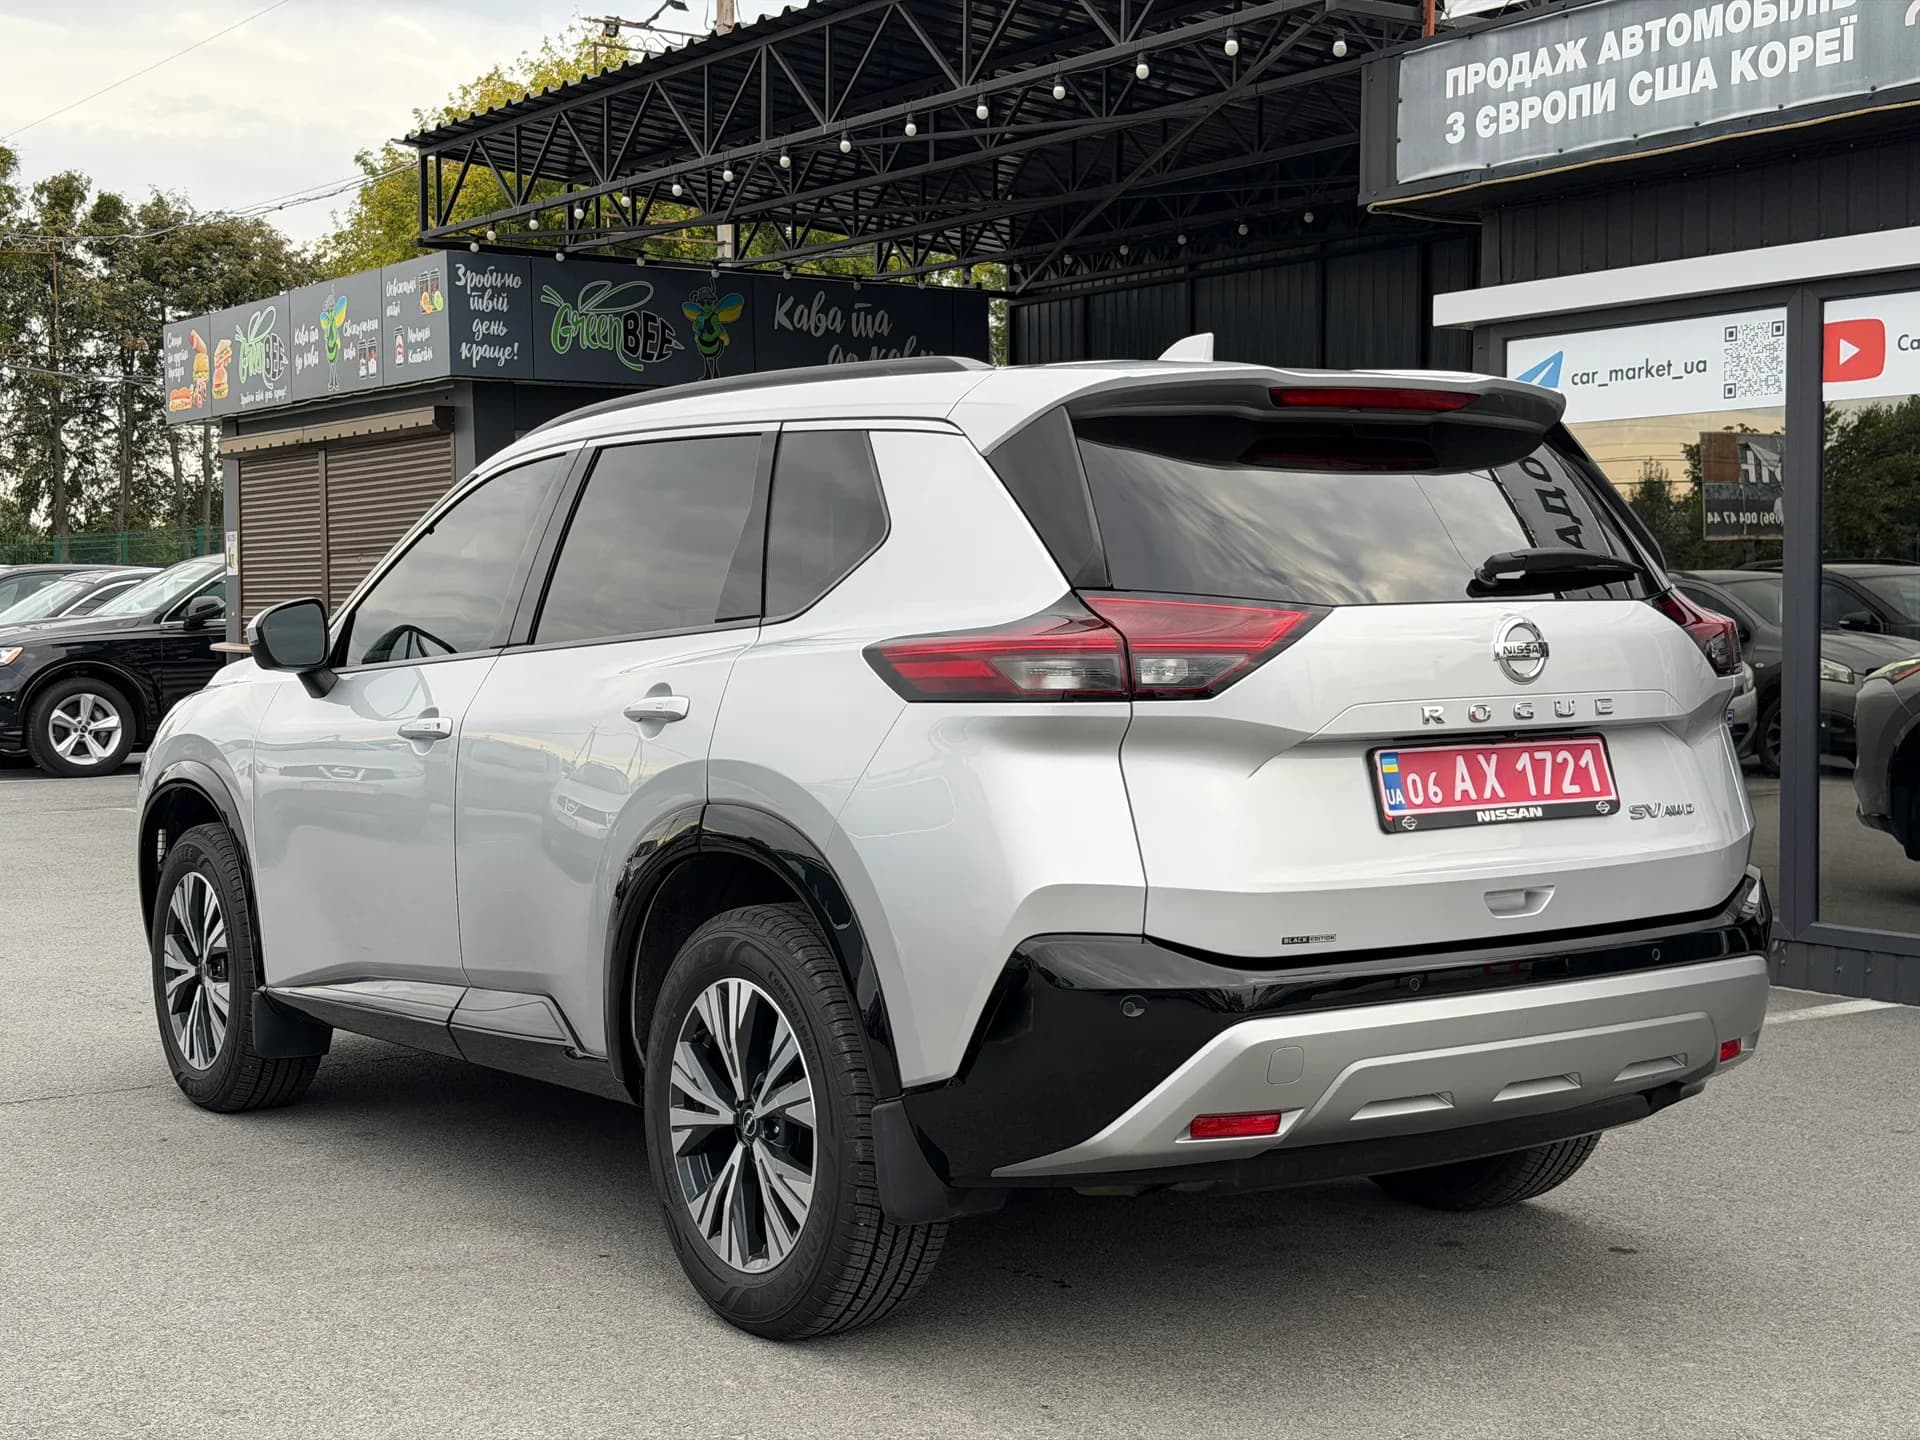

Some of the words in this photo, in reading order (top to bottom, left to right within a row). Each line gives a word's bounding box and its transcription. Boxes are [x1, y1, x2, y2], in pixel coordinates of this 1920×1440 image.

[1446, 37, 1587, 99] ПРОДАЖ
[1597, 0, 1857, 65] АВТОМОБІЛ
[1445, 112, 1465, 144] З
[1476, 78, 1616, 139] ЄВРОПИ
[1628, 56, 1718, 106] США
[1731, 15, 1858, 85] КОРЕЇ
[455, 263, 522, 295] Зробимо
[469, 288, 509, 312] твій
[774, 290, 846, 337] Кава
[851, 303, 892, 338] та
[472, 318, 508, 341] день
[459, 342, 519, 368] краще!
[1571, 358, 1707, 387] car_market_ua
[1421, 698, 1614, 725] ROGUE
[1407, 772, 1443, 805] 06
[1454, 754, 1505, 801] AX
[1515, 749, 1601, 796] 1721
[1386, 788, 1406, 806] UA
[1476, 806, 1543, 822] NISSAN
[1629, 802, 1661, 820] SV
